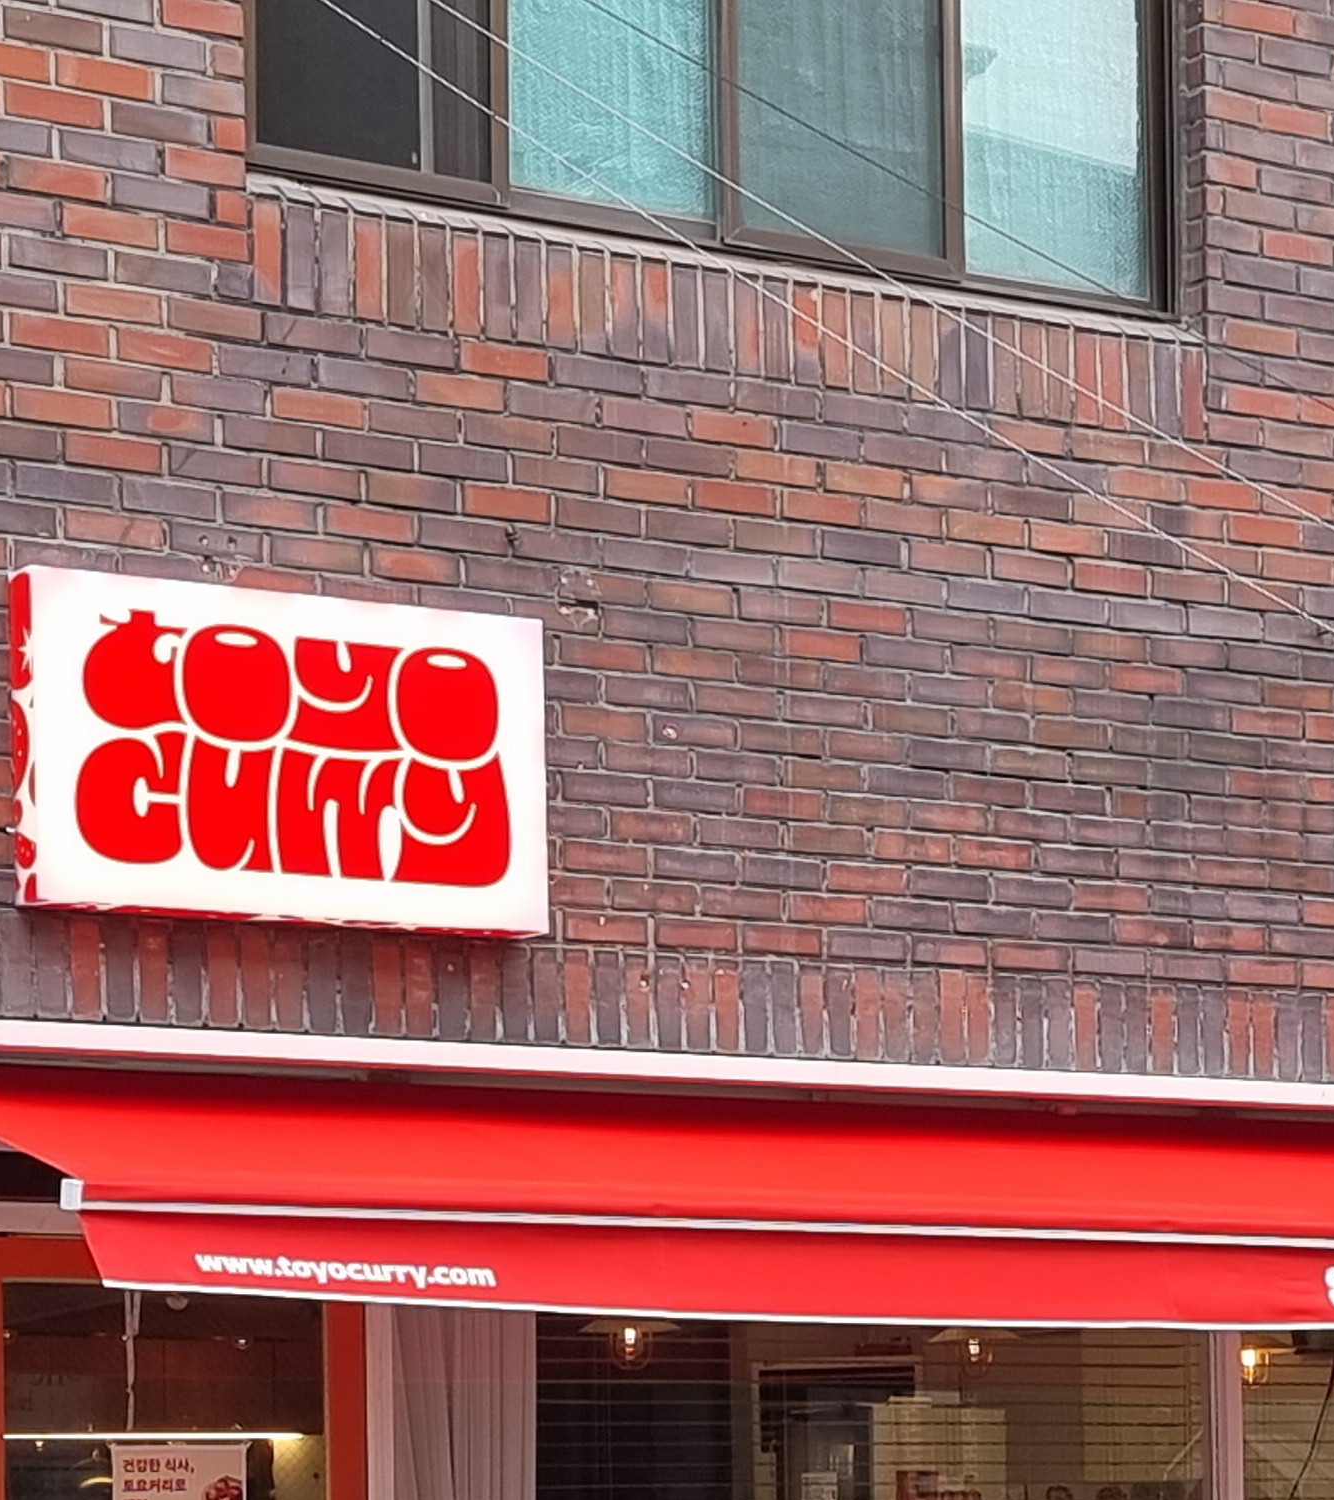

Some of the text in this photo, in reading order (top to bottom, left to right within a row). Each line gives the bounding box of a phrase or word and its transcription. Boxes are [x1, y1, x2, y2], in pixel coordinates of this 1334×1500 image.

[83, 609, 498, 762] toyo
[76, 731, 511, 888] curry
[195, 1253, 497, 1289] www.toyocurry.com
[122, 1457, 161, 1473] 건강한
